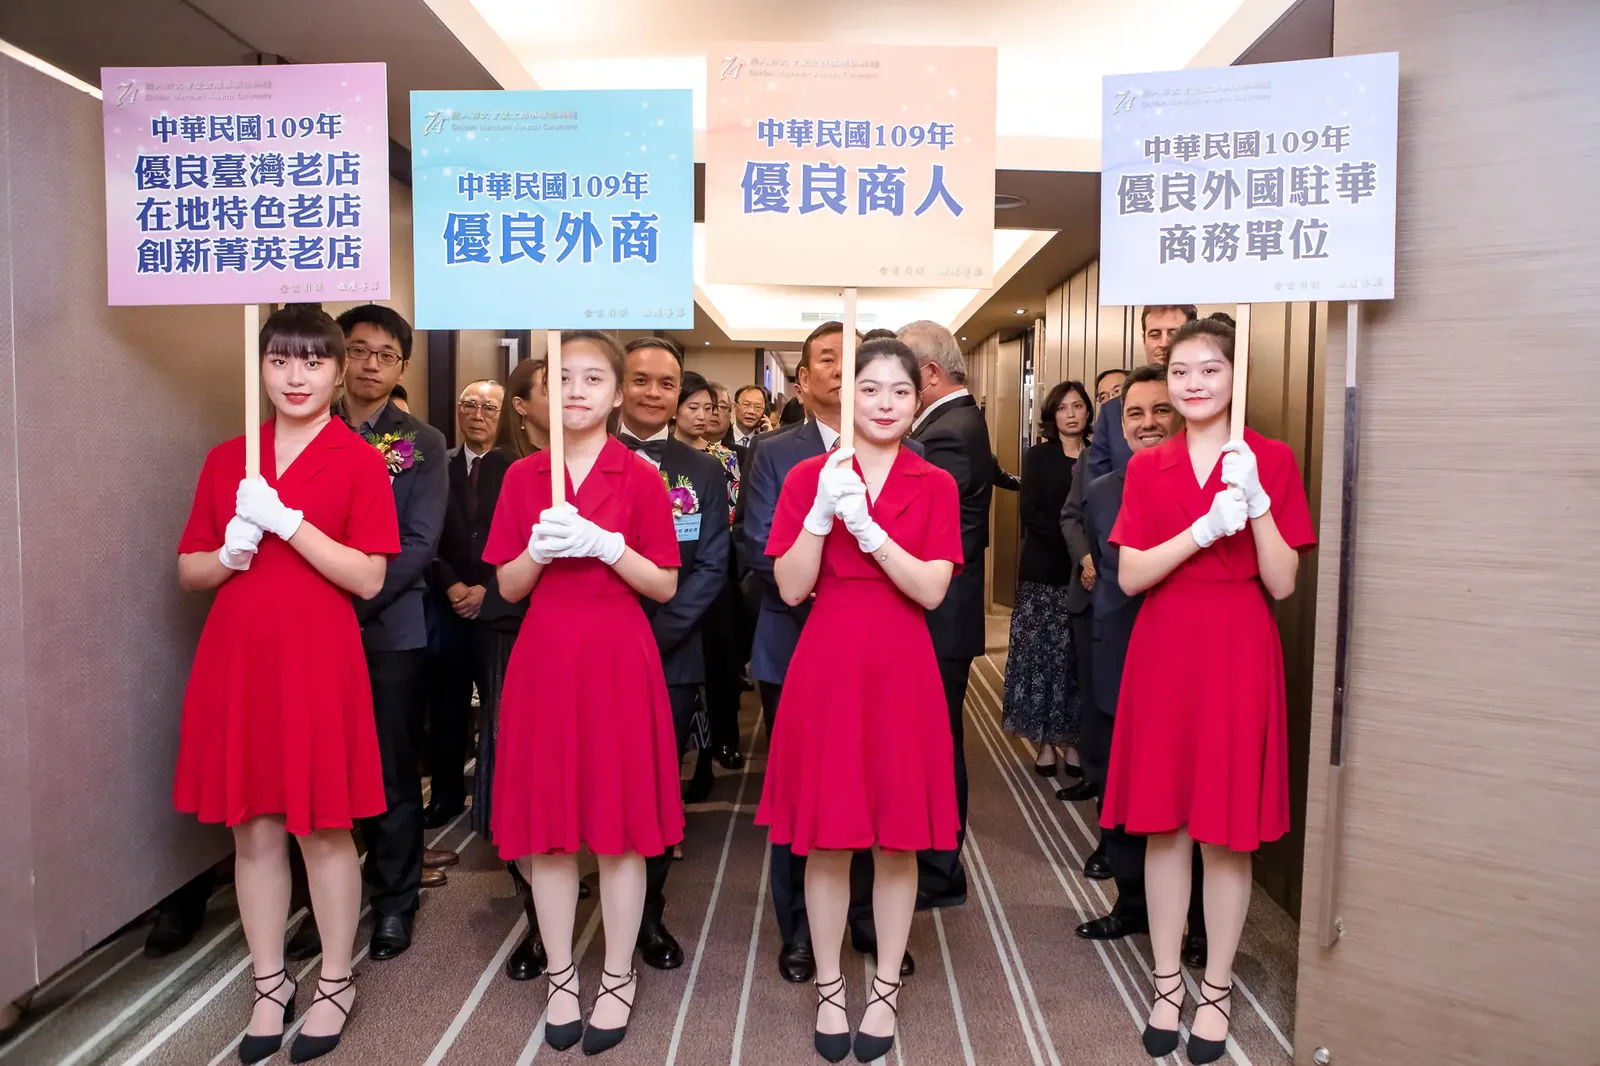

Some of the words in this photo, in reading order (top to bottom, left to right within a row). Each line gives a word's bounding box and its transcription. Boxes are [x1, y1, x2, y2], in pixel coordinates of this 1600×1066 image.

[151, 112, 342, 143] 中華民國109年
[758, 118, 954, 150] 中華民國109年
[1144, 125, 1350, 163] 中華民國109年
[134, 151, 360, 190] 優良臺灣老店
[458, 171, 648, 201] 中華民國109年
[741, 161, 964, 217] 優良商人
[1117, 161, 1376, 215] 優良外國駐華
[136, 193, 361, 231] 在地特色老店
[137, 234, 362, 273] 創新菁英老店
[443, 211, 658, 264] 優良外商
[1159, 218, 1329, 264] 商務單位
